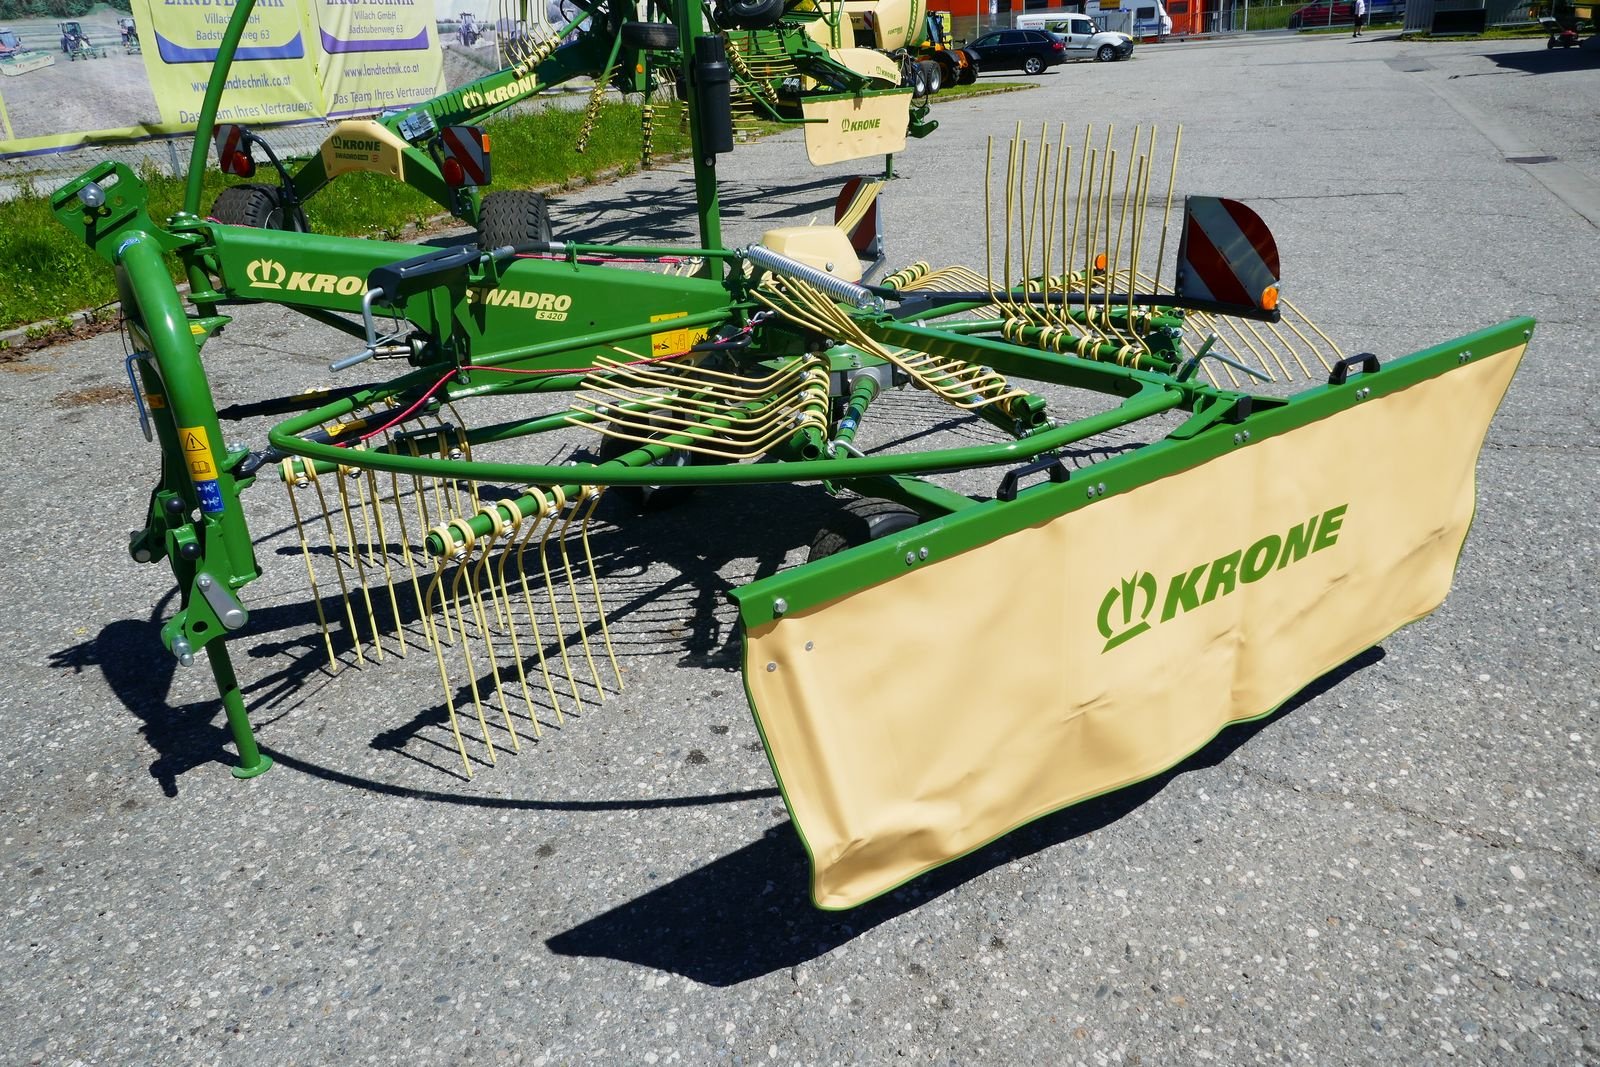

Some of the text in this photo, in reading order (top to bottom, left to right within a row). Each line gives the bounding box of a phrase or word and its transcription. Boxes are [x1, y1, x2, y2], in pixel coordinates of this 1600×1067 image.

[354, 11, 397, 20] Villach GmbH
[260, 29, 270, 40] 63
[349, 24, 404, 35] Badstubenweg 63
[344, 62, 420, 77] www.landtechnik.co.at
[333, 93, 348, 105] Das
[350, 91, 372, 103] Team
[374, 89, 394, 100] Ihres
[216, 109, 233, 120] am
[234, 104, 261, 119] Ihres
[260, 101, 314, 116] Vertrauens
[850, 118, 880, 131] KRONE
[343, 140, 381, 151] KRONE
[286, 271, 369, 296] KRO
[547, 312, 563, 320] 420
[1160, 503, 1348, 624] KRONE
